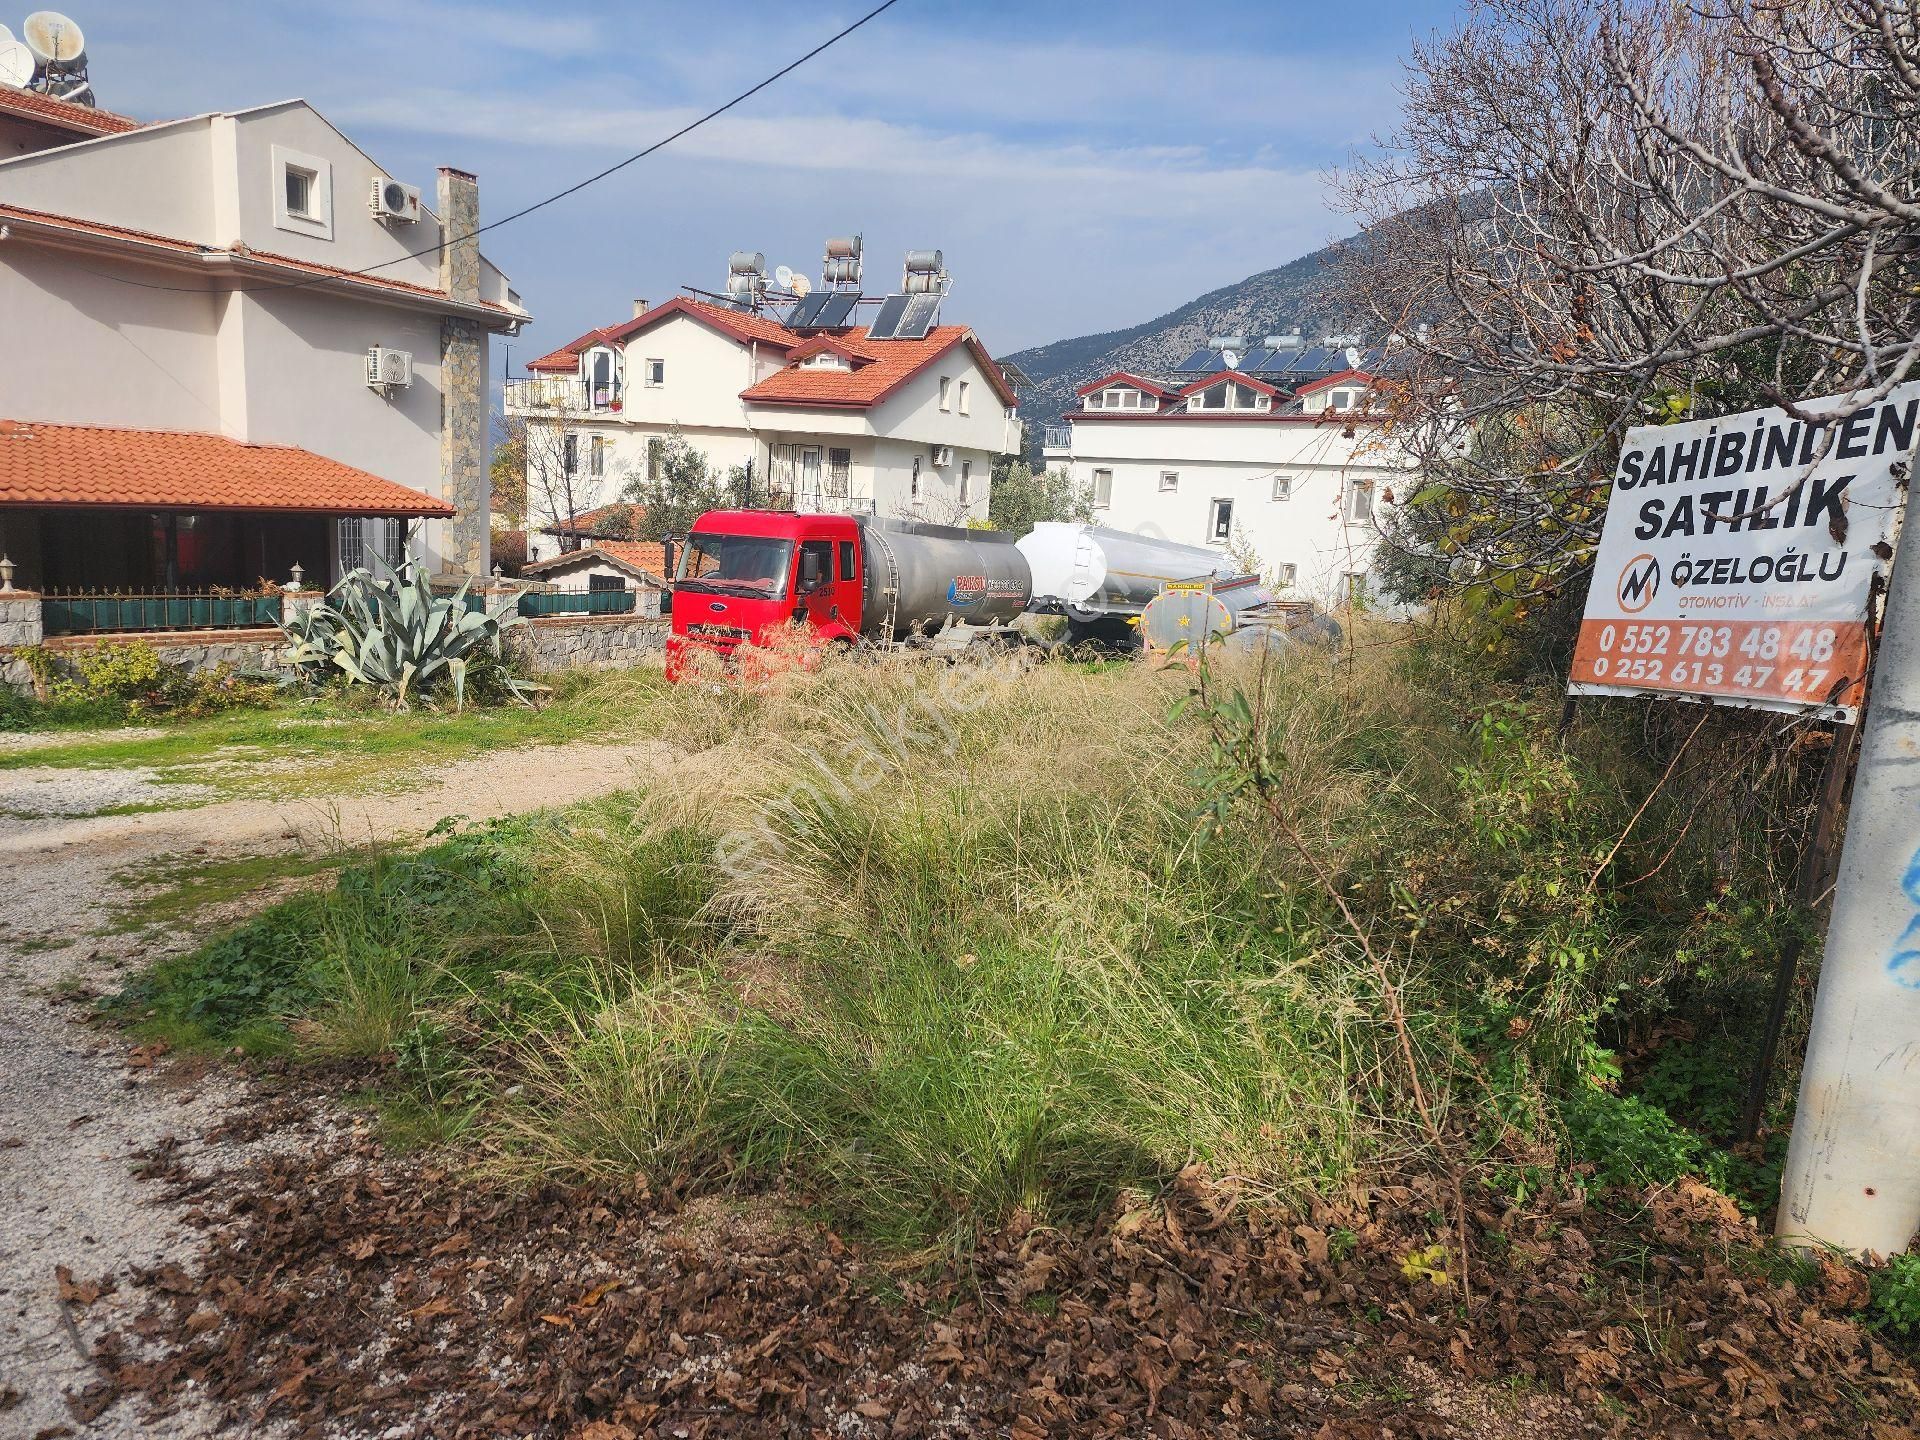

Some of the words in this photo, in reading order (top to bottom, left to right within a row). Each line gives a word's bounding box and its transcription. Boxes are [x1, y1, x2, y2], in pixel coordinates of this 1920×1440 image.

[1617, 399, 1919, 491] SAHİBİNDEN
[1634, 475, 1857, 541] SATILIK
[1671, 547, 1848, 588] ÖZELOĞLU
[1679, 593, 1750, 609] OTOMOTİV
[1600, 625, 1616, 652] 0
[1620, 625, 1671, 655] 552
[1677, 626, 1732, 658] 783
[1740, 628, 1781, 661] 48
[1790, 628, 1837, 663] 48
[1593, 657, 1609, 677] 0
[1614, 658, 1664, 681] 252
[1670, 661, 1724, 685] 613
[1732, 665, 1776, 689] 47
[1782, 668, 1830, 693] 47
